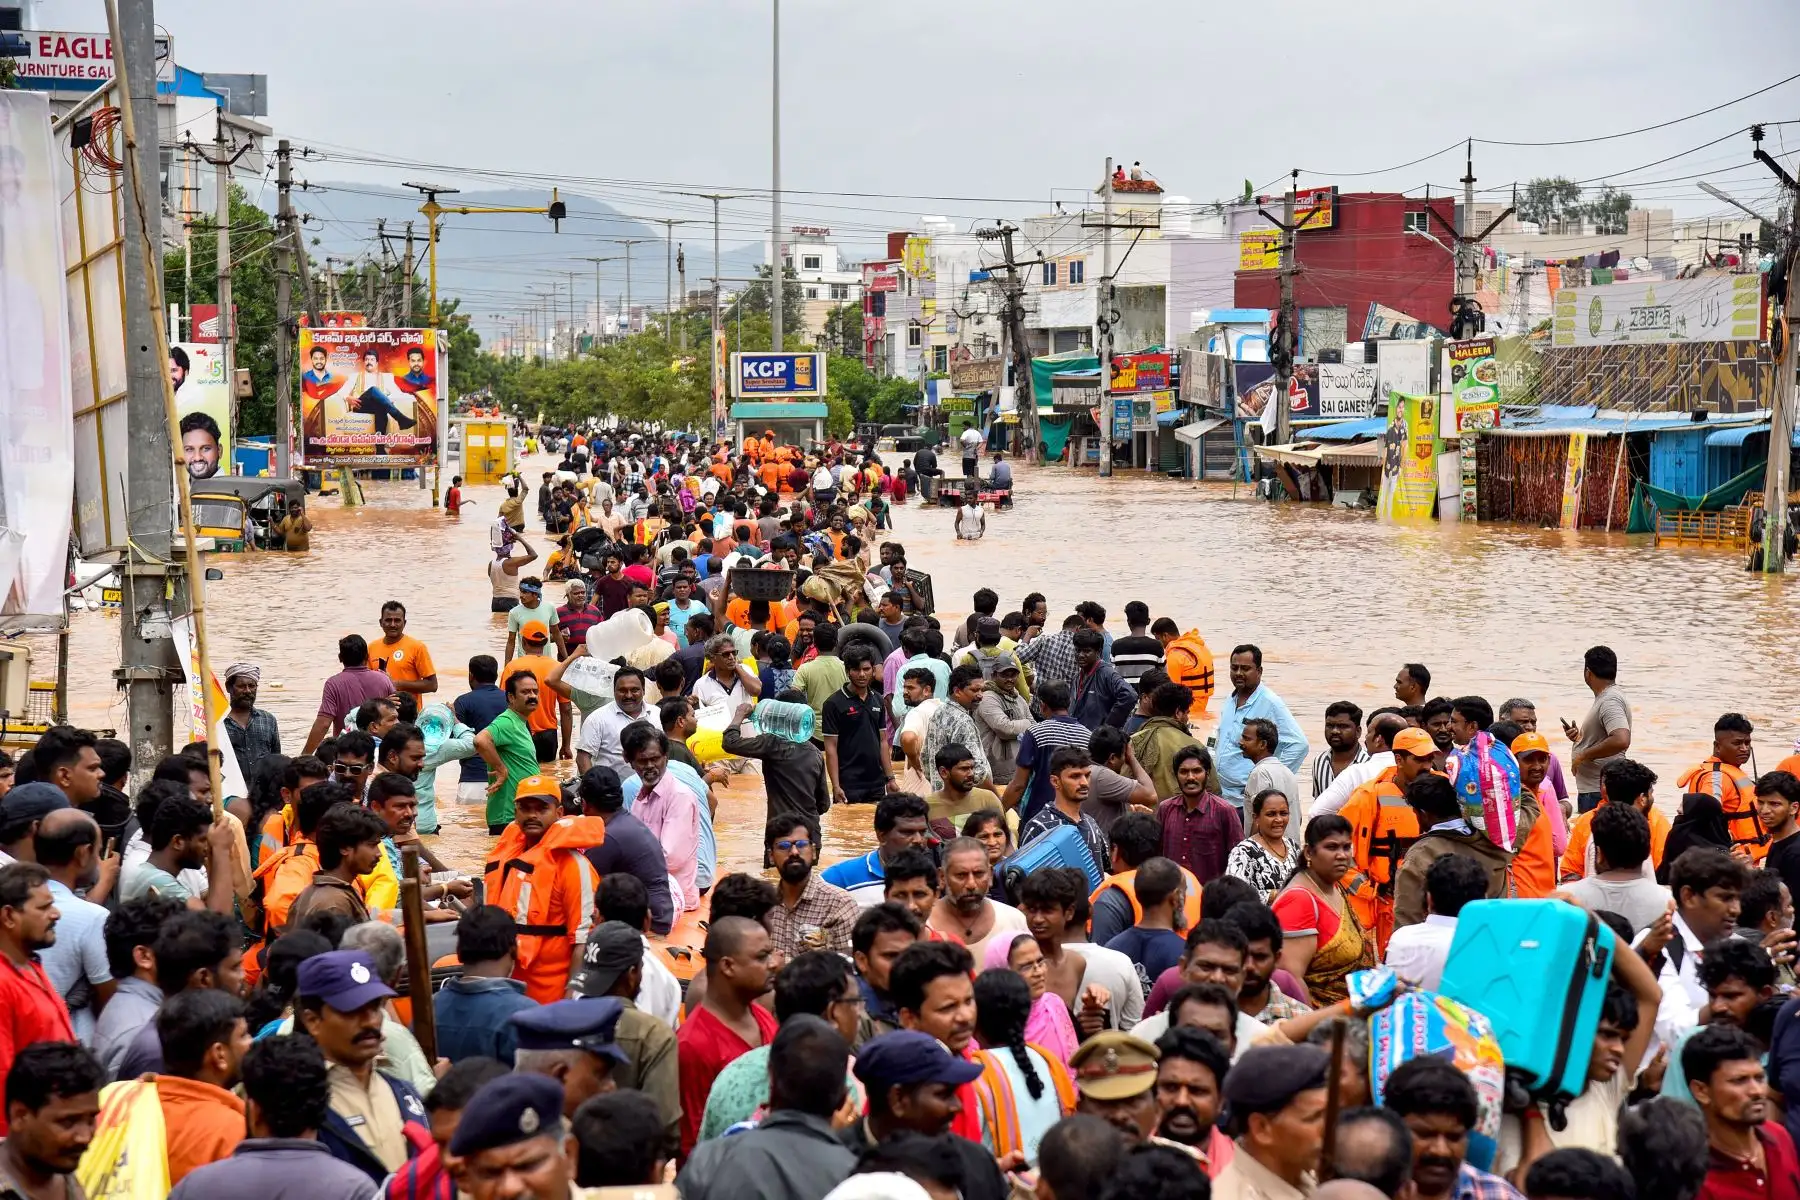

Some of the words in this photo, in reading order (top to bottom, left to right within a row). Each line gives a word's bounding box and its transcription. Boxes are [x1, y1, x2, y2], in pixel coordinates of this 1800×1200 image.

[39, 36, 113, 59] EAGLE
[18, 63, 84, 77] URNITURE
[88, 65, 115, 78] GAL
[1630, 307, 1670, 327] zaara
[1455, 347, 1491, 358] HALEEM
[743, 361, 787, 377] KCP
[1322, 400, 1335, 413] SAI
